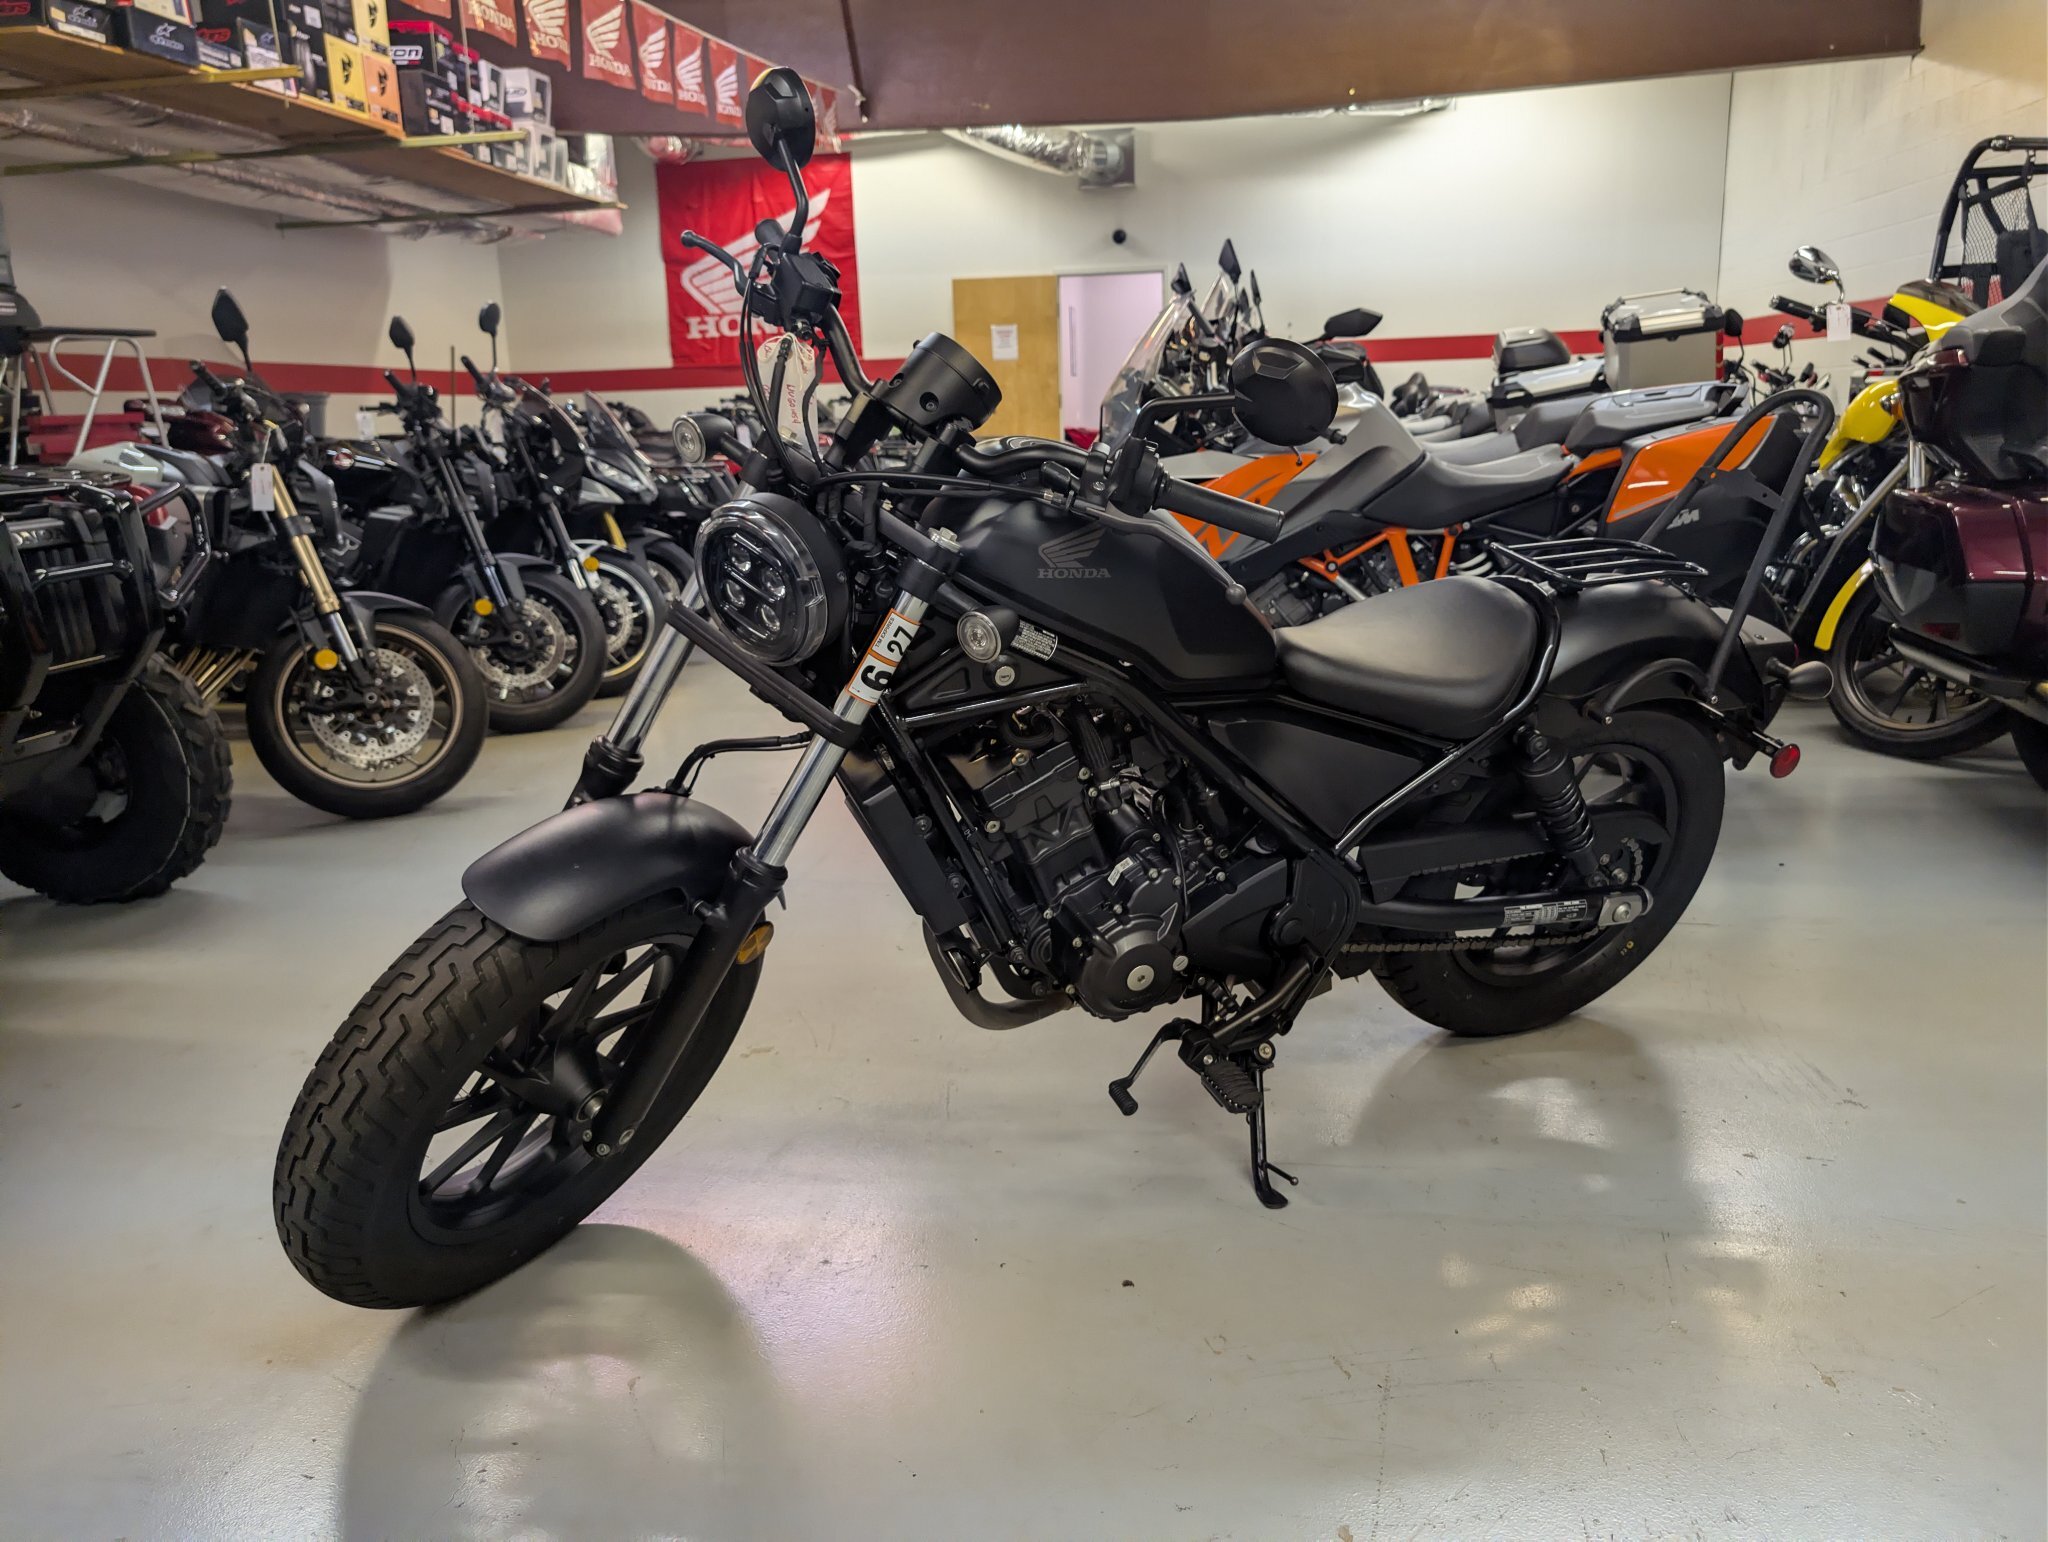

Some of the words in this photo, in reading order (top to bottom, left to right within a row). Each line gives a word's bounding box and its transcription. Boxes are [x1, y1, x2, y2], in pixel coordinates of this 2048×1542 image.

[686, 316, 781, 339] HON
[1037, 568, 1112, 579] HONDA
[880, 617, 895, 639] EXPIRES
[887, 625, 913, 656] 27
[861, 665, 892, 692] 6
